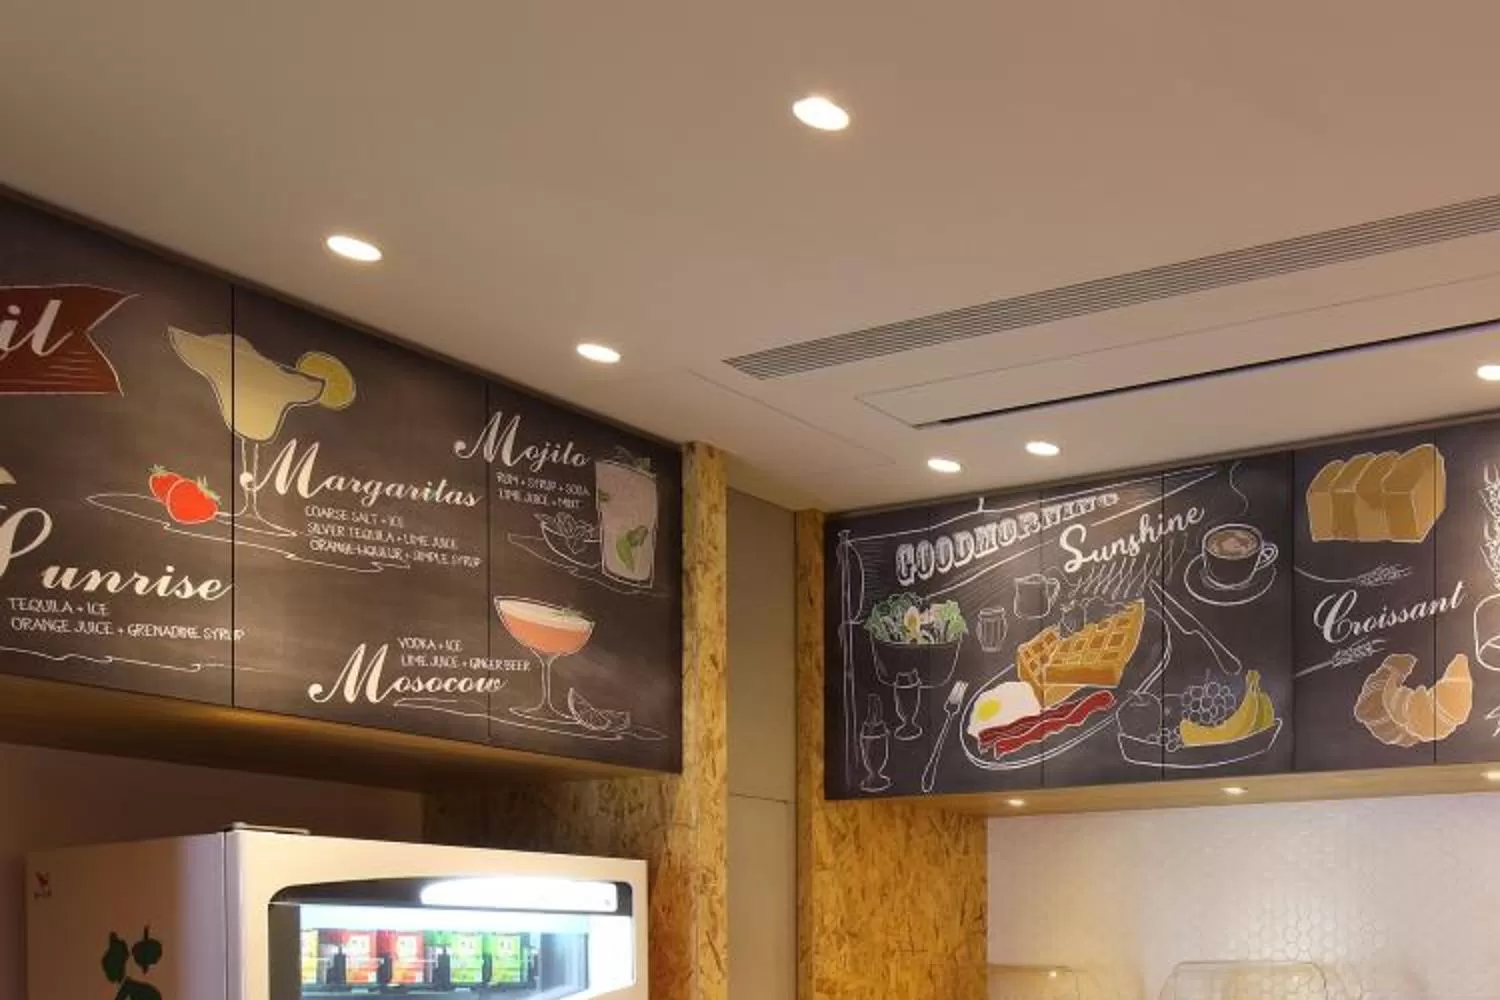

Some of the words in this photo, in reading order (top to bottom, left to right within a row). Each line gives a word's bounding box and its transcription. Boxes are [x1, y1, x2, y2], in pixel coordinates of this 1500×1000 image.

[454, 411, 591, 472] Mojito
[239, 438, 484, 507] Margaritas
[1058, 506, 1205, 573] Sunshine
[9, 597, 73, 614] TEQUILA
[87, 600, 110, 616] ICE
[12, 617, 72, 633] ORANGE
[75, 620, 114, 636] JUICE
[127, 623, 201, 640] GRENADINE
[1314, 581, 1467, 643] Croissant
[308, 644, 507, 704] Mosocow
